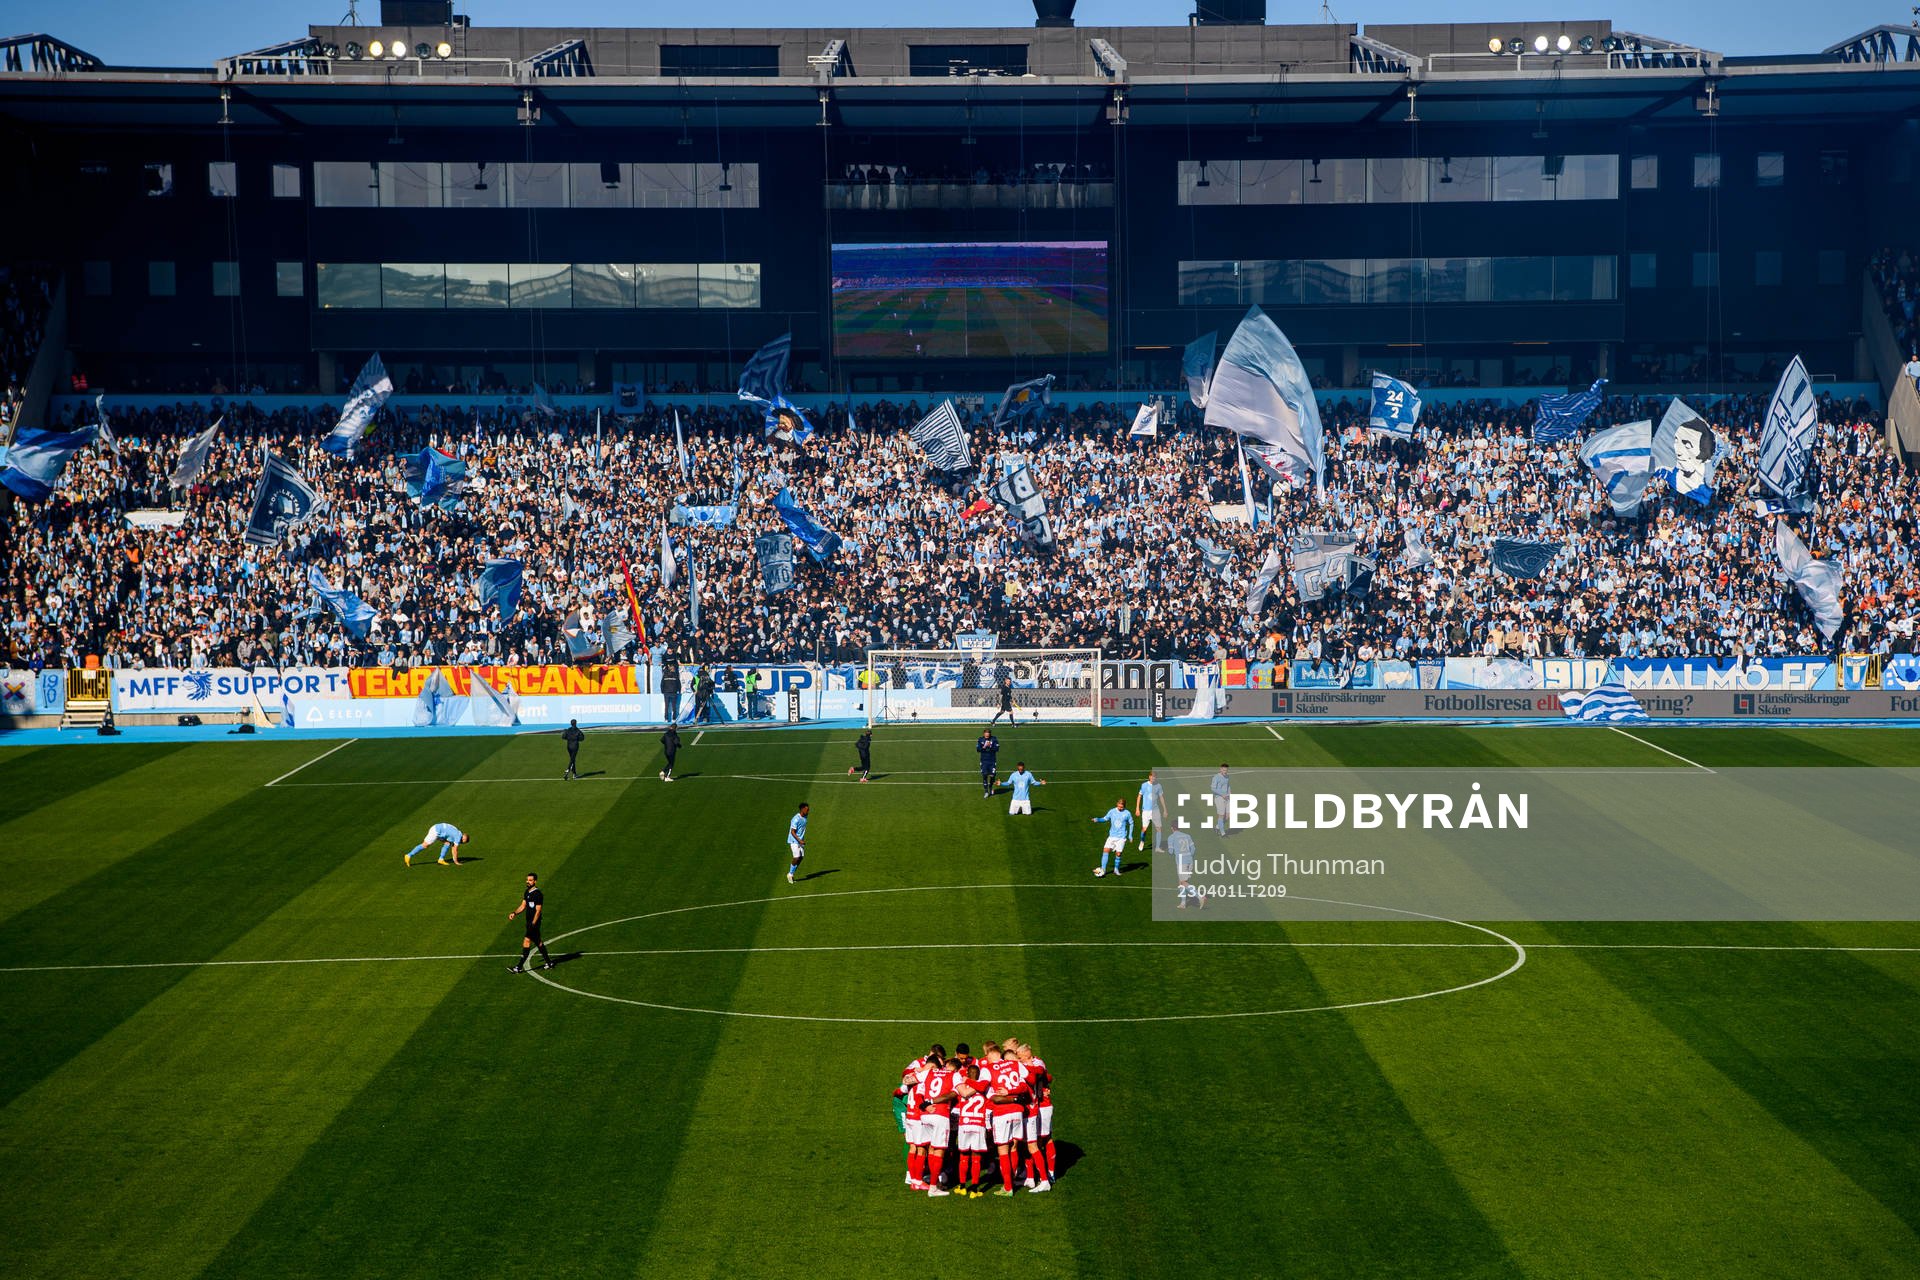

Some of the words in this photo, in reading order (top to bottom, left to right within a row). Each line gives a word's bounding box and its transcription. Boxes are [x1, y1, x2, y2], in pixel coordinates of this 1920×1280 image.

[1386, 389, 1404, 403] 24
[1390, 406, 1400, 419] 2
[1623, 657, 1770, 690] MALMÖ
[1782, 662, 1826, 690] FF
[129, 677, 180, 698] MFF
[217, 673, 340, 696] SUPPORT
[1296, 692, 1387, 705] Länsförsäkringar
[1424, 694, 1532, 711] Fotbollsresa
[1637, 694, 1694, 716] ering?
[1757, 693, 1850, 706] Länsförsäkringar
[328, 709, 374, 719] ELEDA
[789, 693, 798, 722] SELECT
[1295, 703, 1328, 714] Skåne
[1757, 705, 1791, 715] Skåne
[929, 1077, 943, 1097] 9
[961, 1094, 985, 1118] 22
